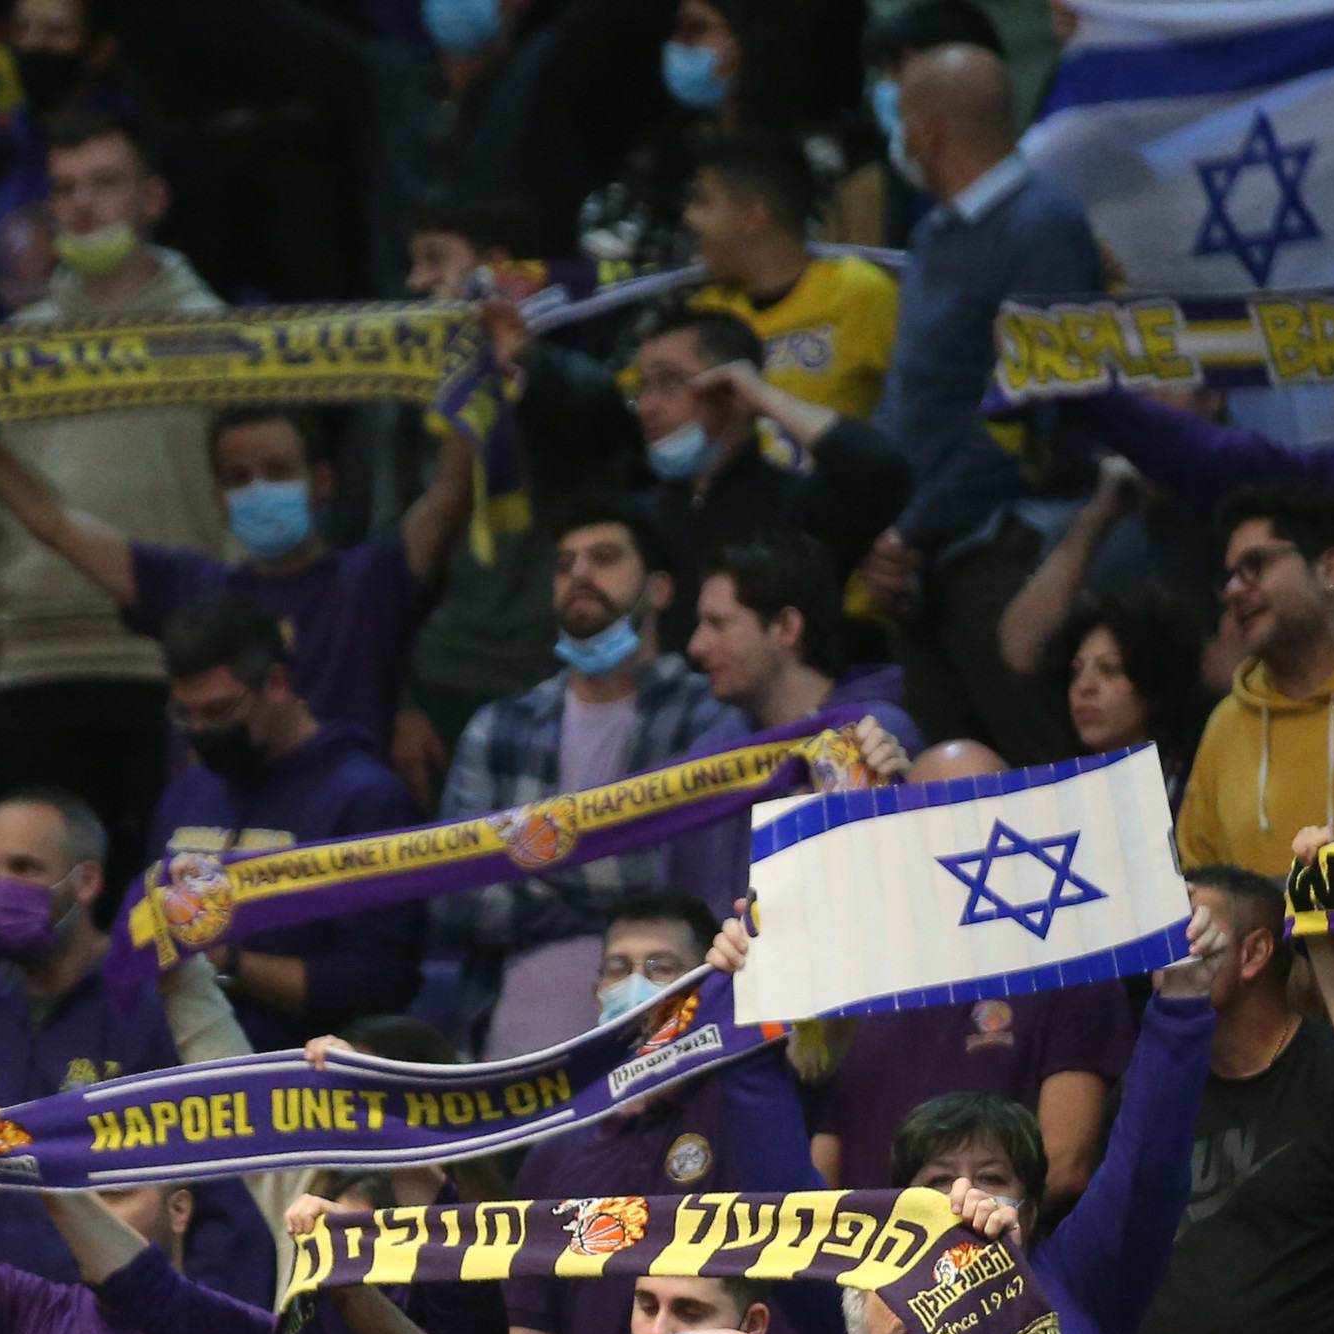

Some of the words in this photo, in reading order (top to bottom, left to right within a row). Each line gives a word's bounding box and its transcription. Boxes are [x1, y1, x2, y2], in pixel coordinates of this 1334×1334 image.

[582, 777, 677, 820] HAPOEL
[680, 758, 746, 798] UNET
[237, 851, 326, 892] HAPOEL
[332, 840, 393, 880] UNET
[398, 823, 482, 866] HOLON
[87, 1090, 253, 1152] HAPOEL
[271, 1083, 387, 1133] UNET
[404, 1068, 571, 1127] HOLON
[979, 1274, 1025, 1316] 1947
